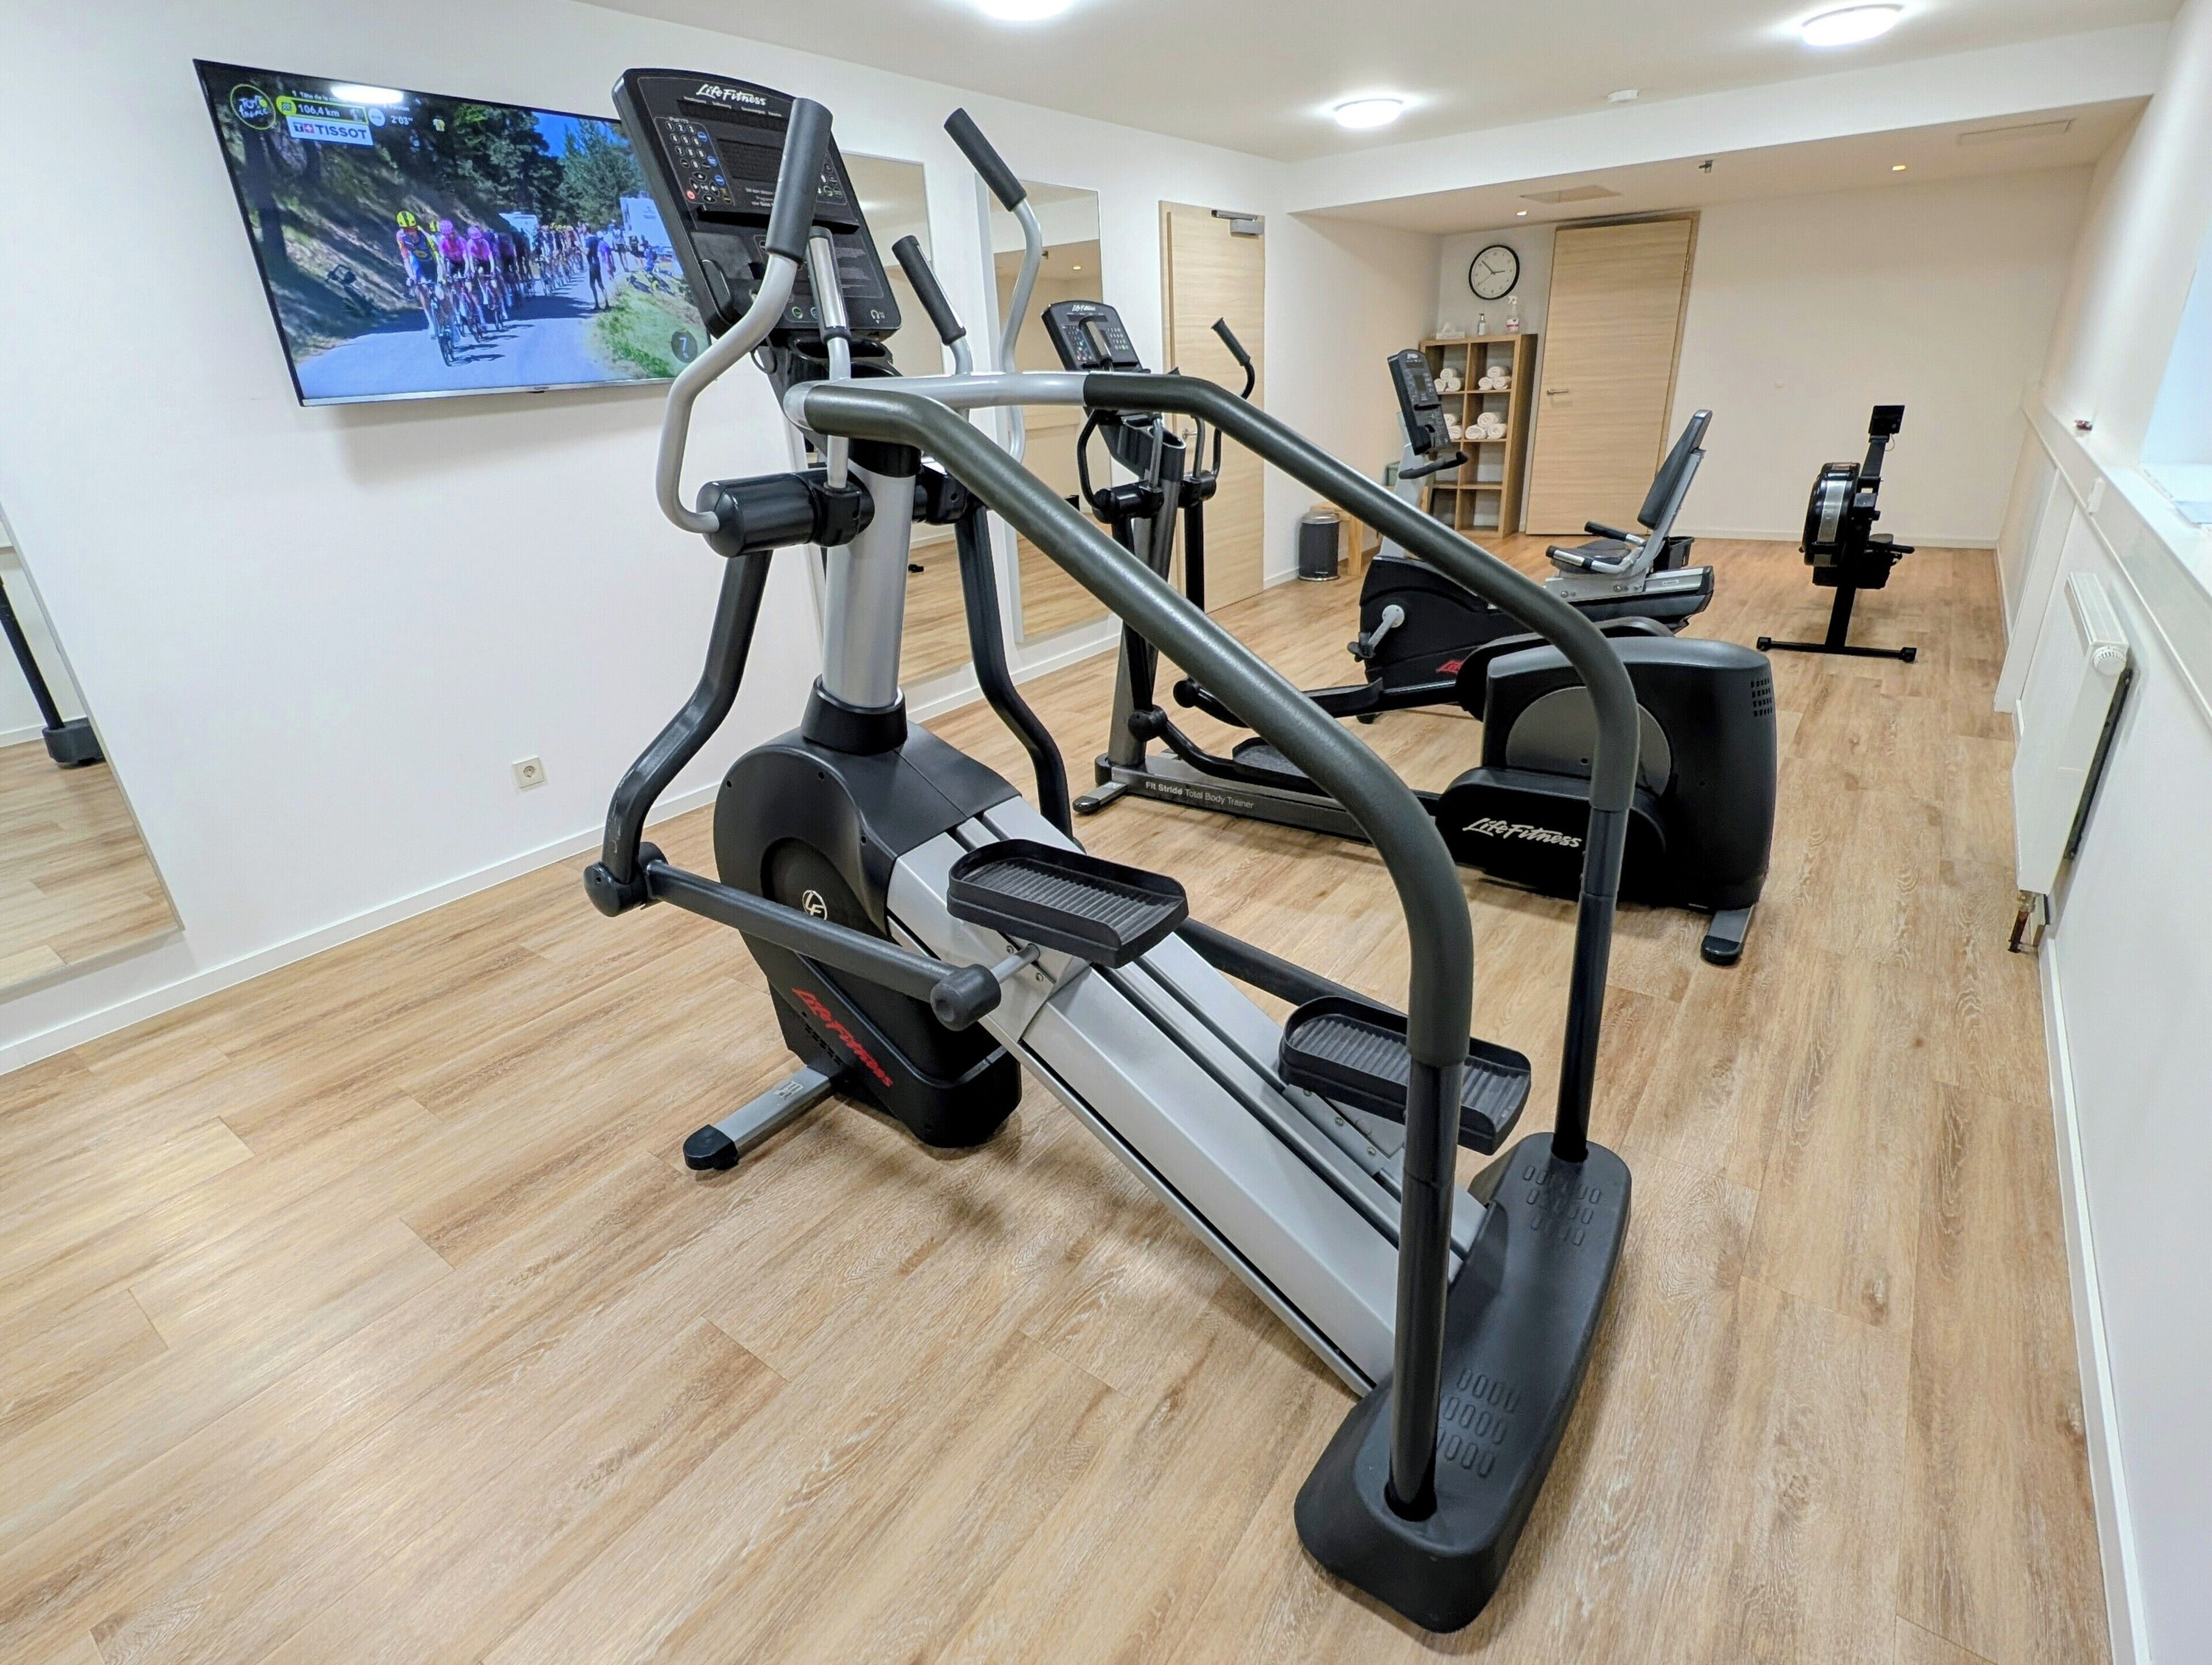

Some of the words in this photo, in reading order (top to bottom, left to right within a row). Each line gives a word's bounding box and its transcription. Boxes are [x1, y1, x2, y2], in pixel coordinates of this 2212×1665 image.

[722, 89, 766, 106] Fitness
[325, 107, 340, 117] km
[315, 124, 367, 139] TISSOT
[1145, 781, 1156, 790] Fit
[1158, 784, 1183, 795] Stride
[1185, 788, 1203, 799] Total
[1205, 792, 1225, 805] Body
[1227, 797, 1254, 809] Trainer
[1462, 817, 1508, 837] Life
[1503, 824, 1582, 848] Fitness
